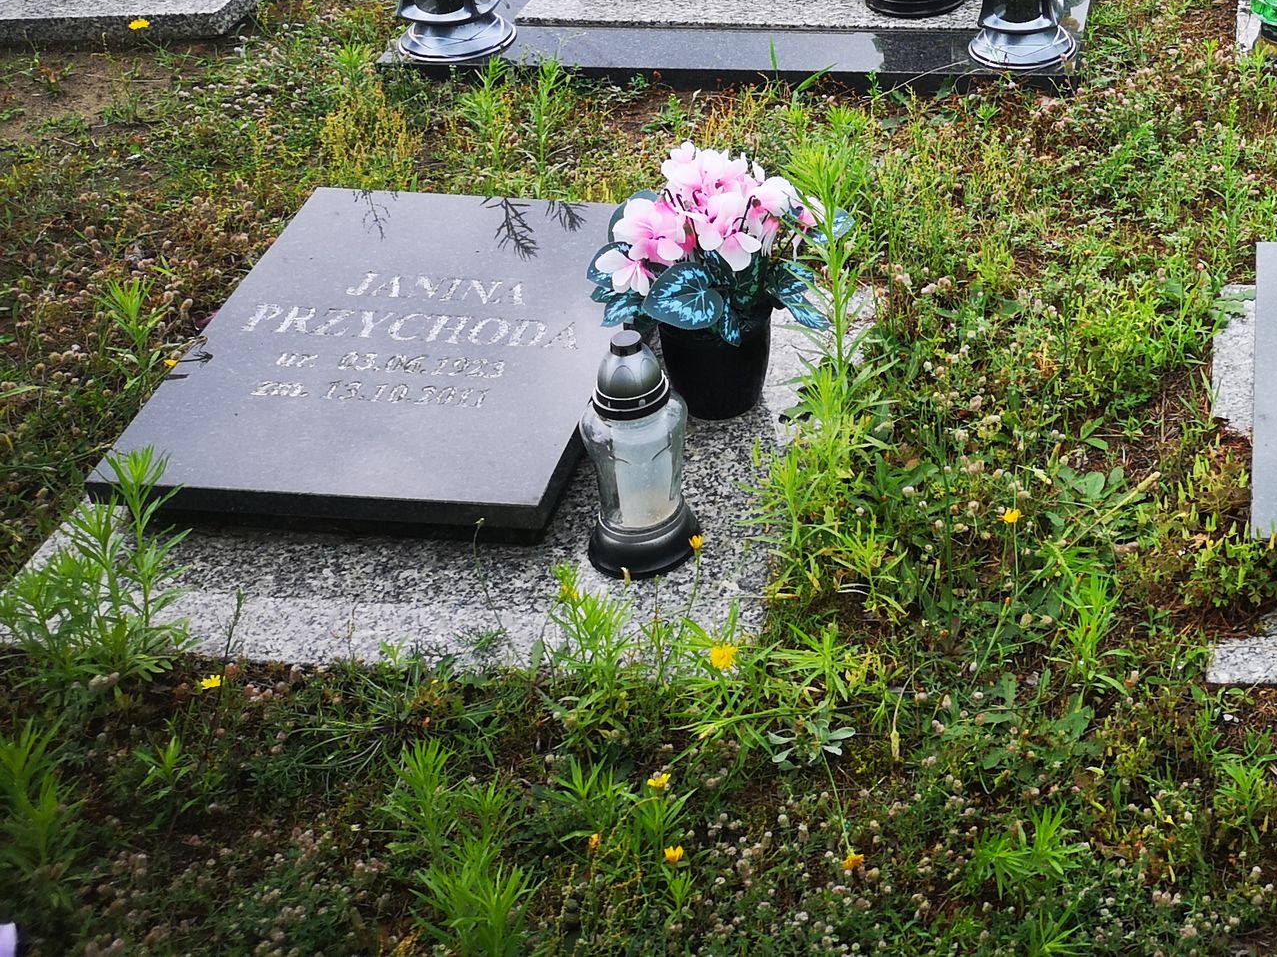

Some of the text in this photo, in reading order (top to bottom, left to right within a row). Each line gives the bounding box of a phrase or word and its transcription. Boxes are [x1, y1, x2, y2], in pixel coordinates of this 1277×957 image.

[345, 270, 526, 306] JANINA
[240, 303, 579, 350] PRZYCHODA
[337, 351, 506, 378] 03.06.1923
[321, 380, 491, 409] 13.10.2011
